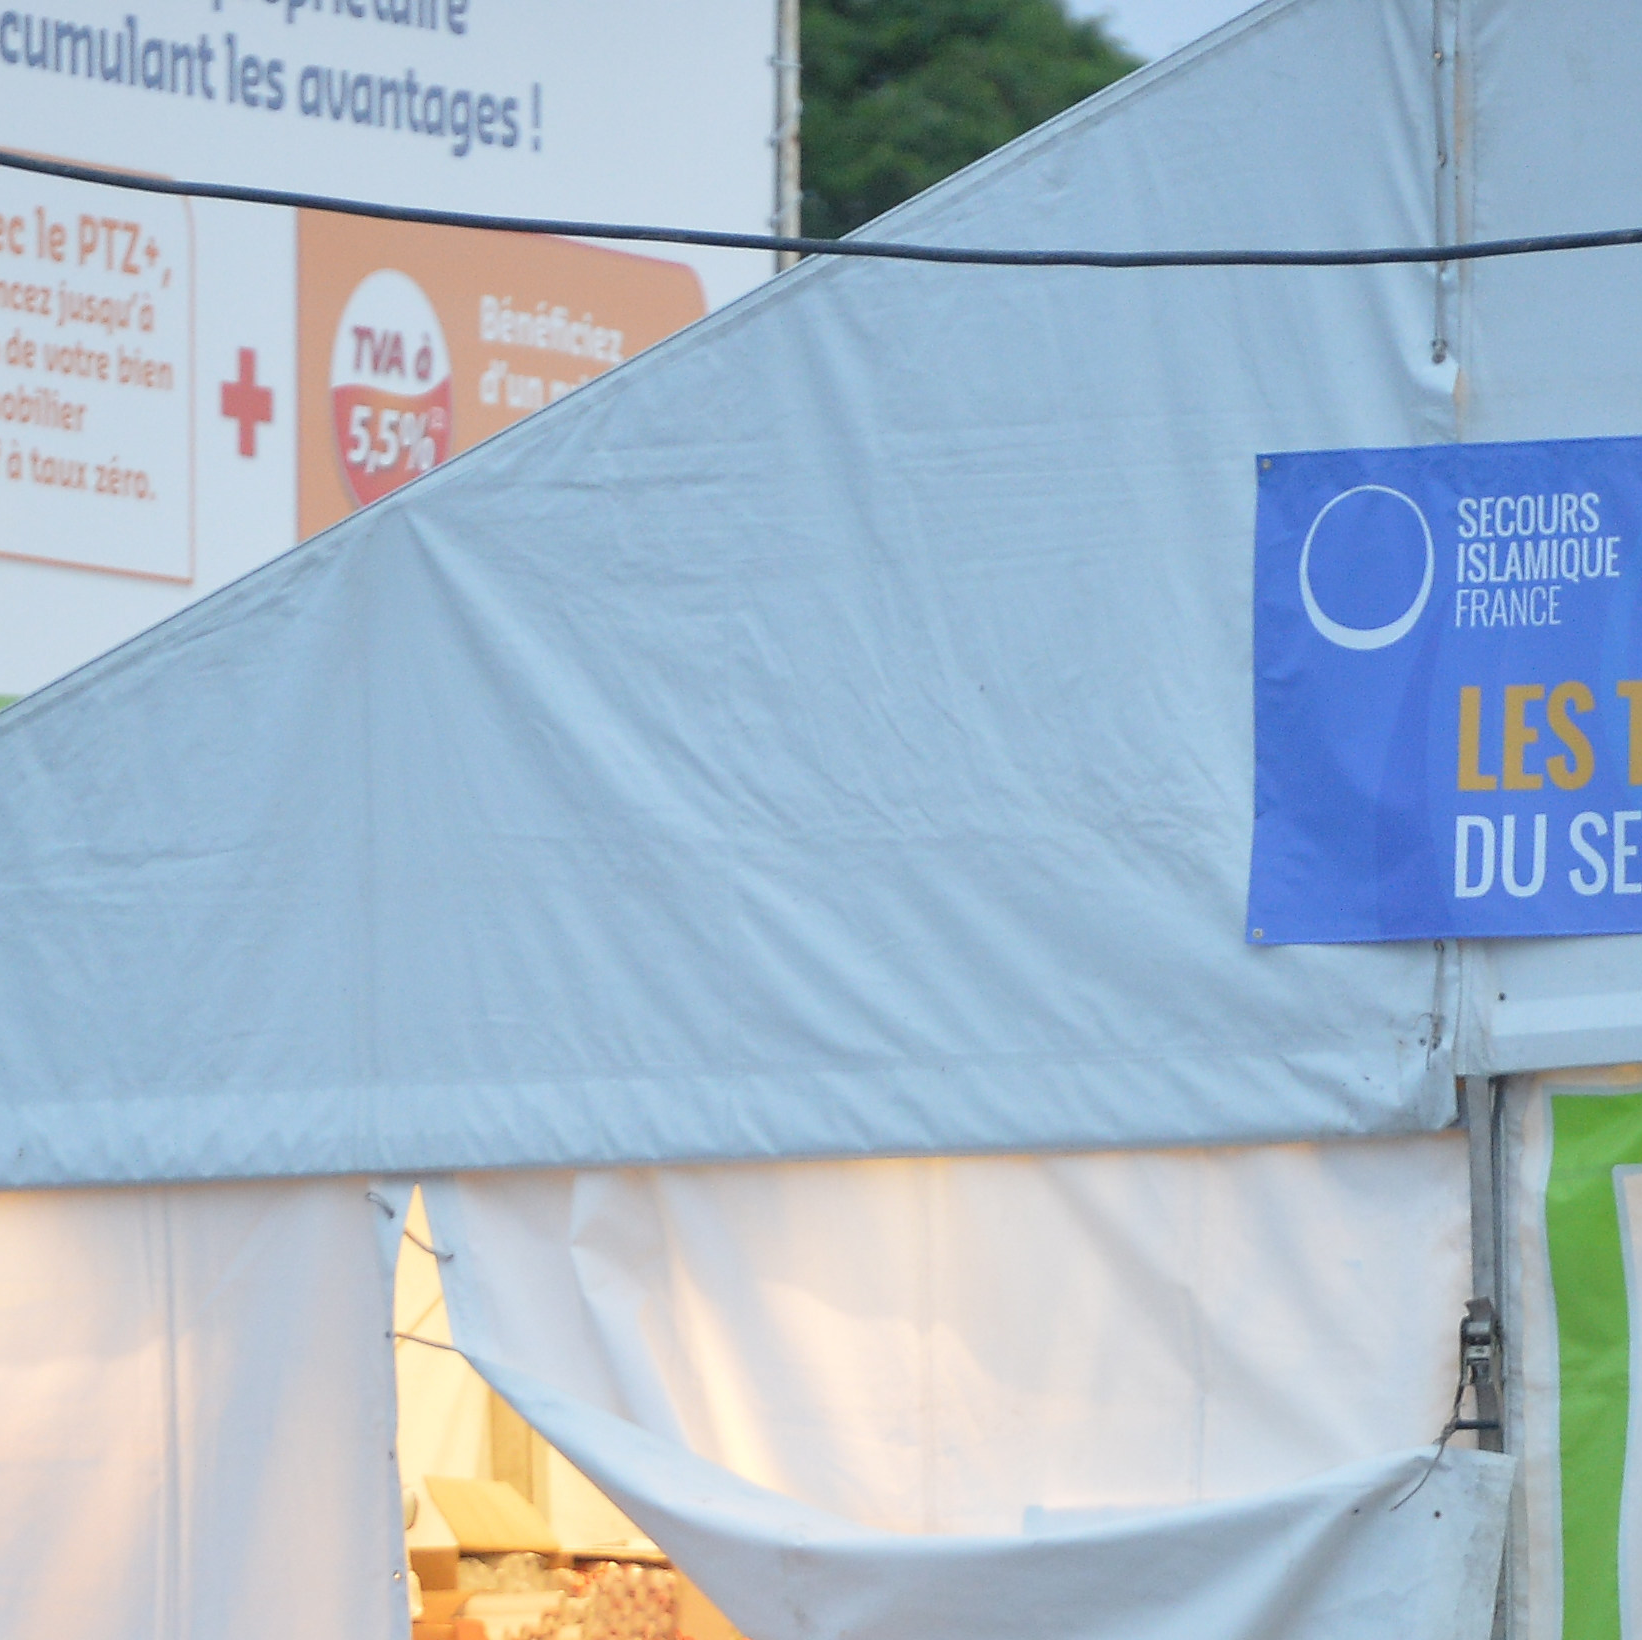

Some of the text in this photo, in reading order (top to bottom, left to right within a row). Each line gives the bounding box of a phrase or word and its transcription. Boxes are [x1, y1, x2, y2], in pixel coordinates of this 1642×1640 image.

[0, 7, 217, 101] cumulant
[225, 32, 287, 111] les
[297, 62, 523, 158] avantages
[35, 204, 67, 263] le
[56, 280, 154, 336] jusqu'à
[478, 293, 624, 365] Bénéficiez
[6, 327, 37, 370] de
[44, 340, 109, 381] votre
[117, 344, 174, 391] bien
[350, 324, 434, 382] TVA à
[8, 438, 23, 481] à
[30, 448, 88, 490] taux
[94, 454, 157, 501] zéro.
[1457, 491, 1601, 539] SECOURS
[1457, 535, 1621, 584] ISLAMIQUE
[1455, 584, 1562, 628] FRANCE
[1456, 680, 1596, 792] LES
[1453, 812, 1548, 899] DU
